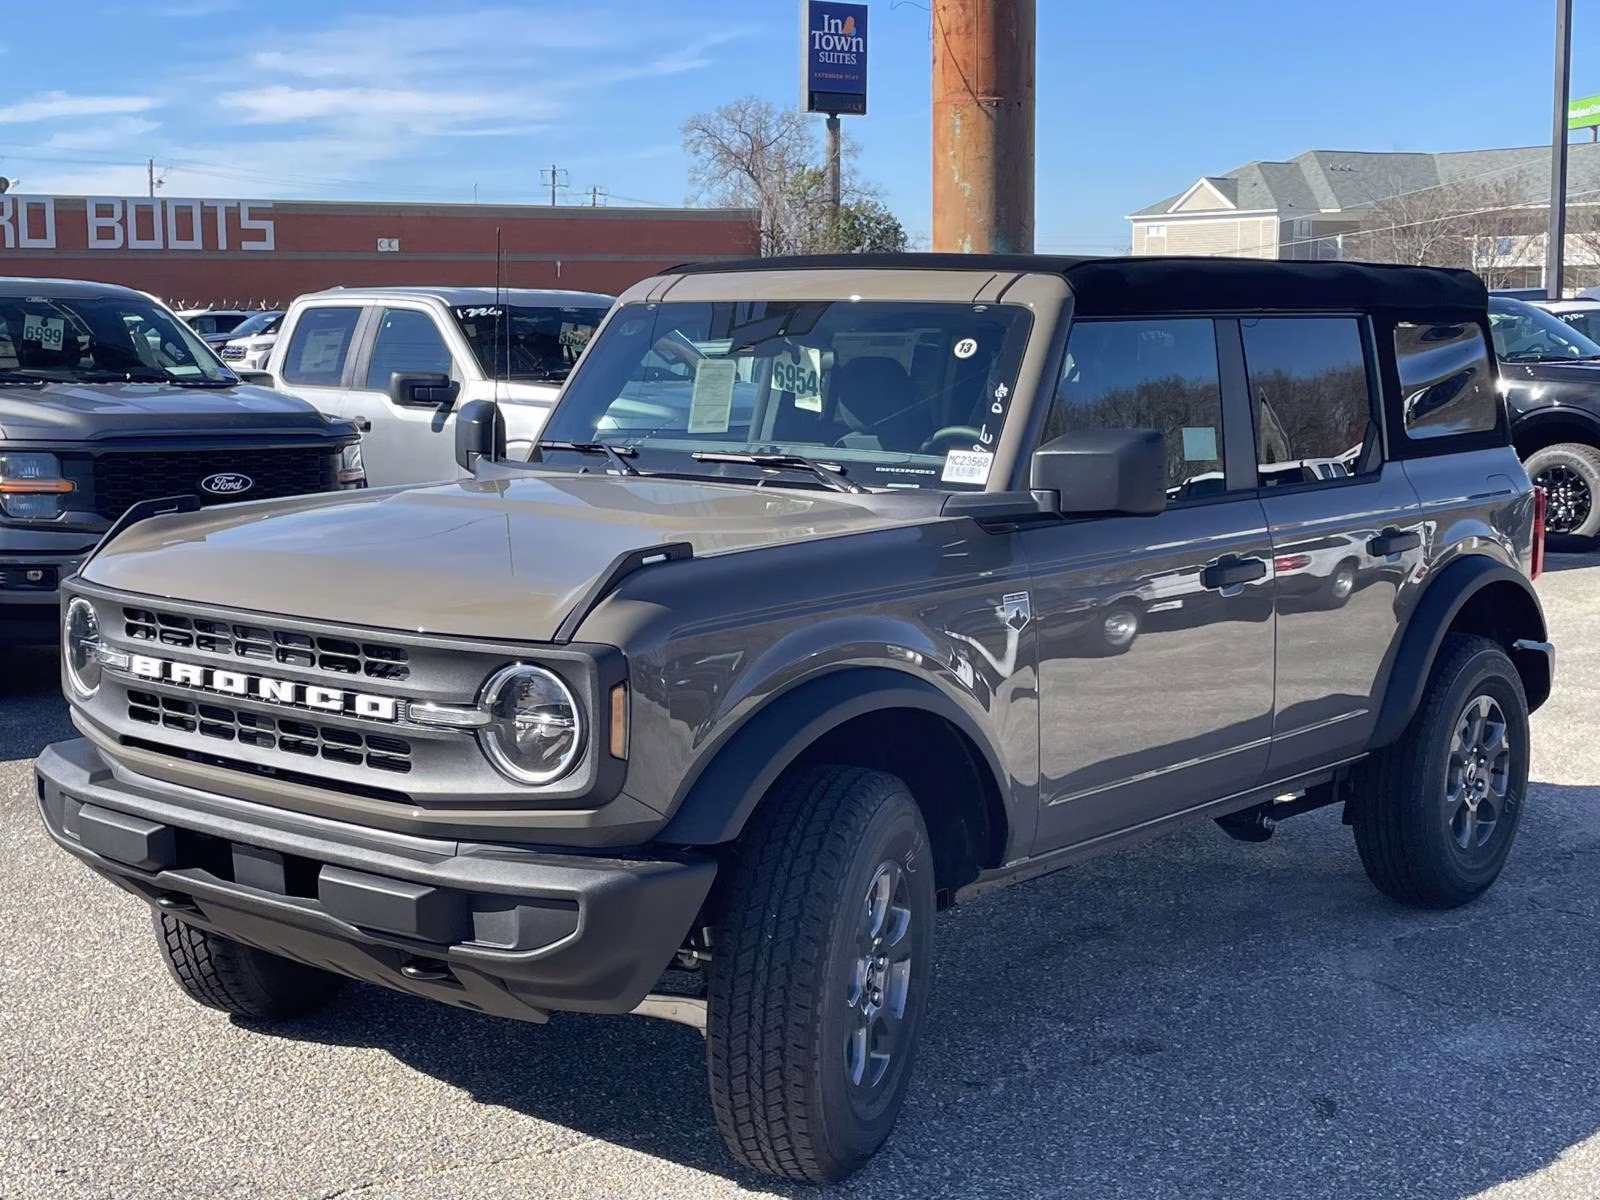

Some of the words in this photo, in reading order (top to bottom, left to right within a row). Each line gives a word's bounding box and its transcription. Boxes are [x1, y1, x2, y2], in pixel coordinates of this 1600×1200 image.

[822, 14, 843, 34] In
[811, 30, 865, 53] Town
[818, 51, 857, 65] SUITES
[86, 197, 276, 251] BOOTS
[957, 342, 974, 354] 13
[773, 361, 819, 397] 6954
[949, 455, 990, 468] MC23568
[211, 475, 243, 491] Ford
[132, 654, 398, 720] BRONCO
